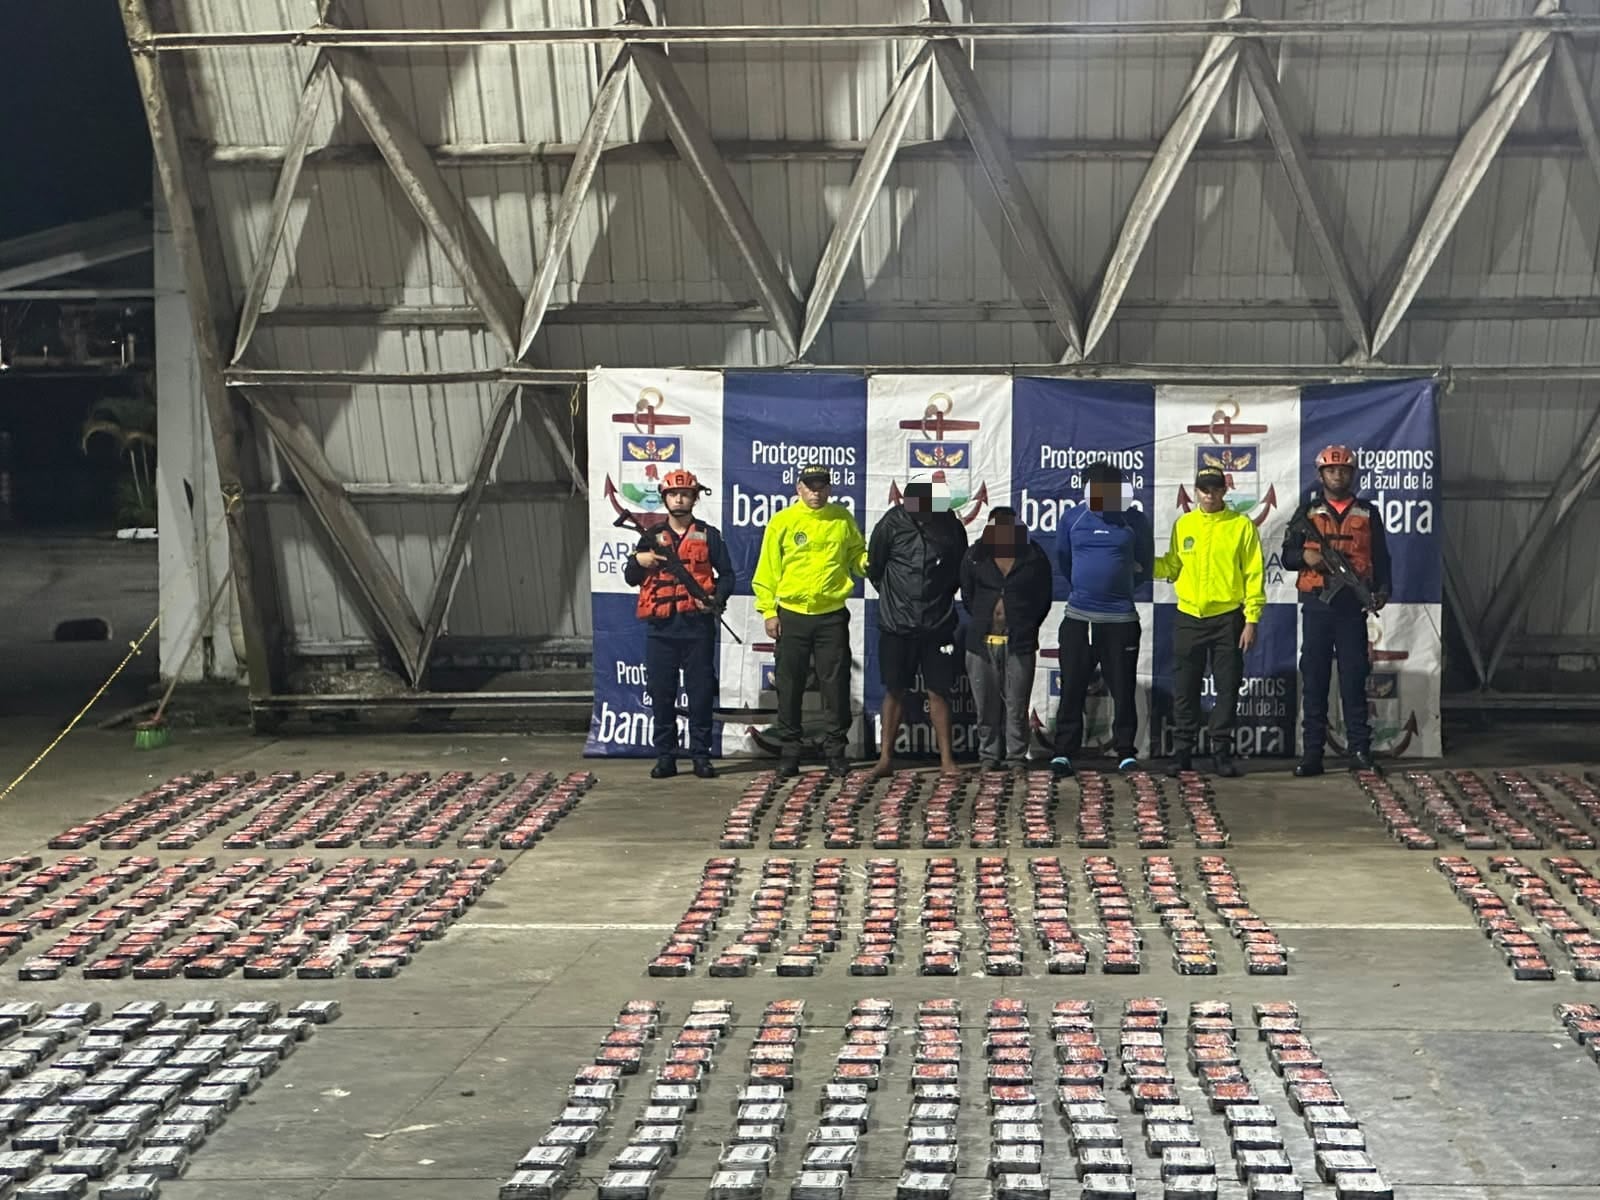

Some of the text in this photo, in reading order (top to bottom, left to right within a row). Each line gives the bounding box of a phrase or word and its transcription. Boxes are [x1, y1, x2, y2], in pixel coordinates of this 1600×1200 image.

[752, 440, 856, 469] Protegemos
[1041, 445, 1144, 470] Protegemos
[1352, 447, 1434, 473] tegemos
[783, 467, 794, 485] el
[844, 468, 855, 485] la
[1132, 472, 1144, 489] la
[1360, 471, 1433, 489] el azul de la
[598, 562, 617, 574] DE
